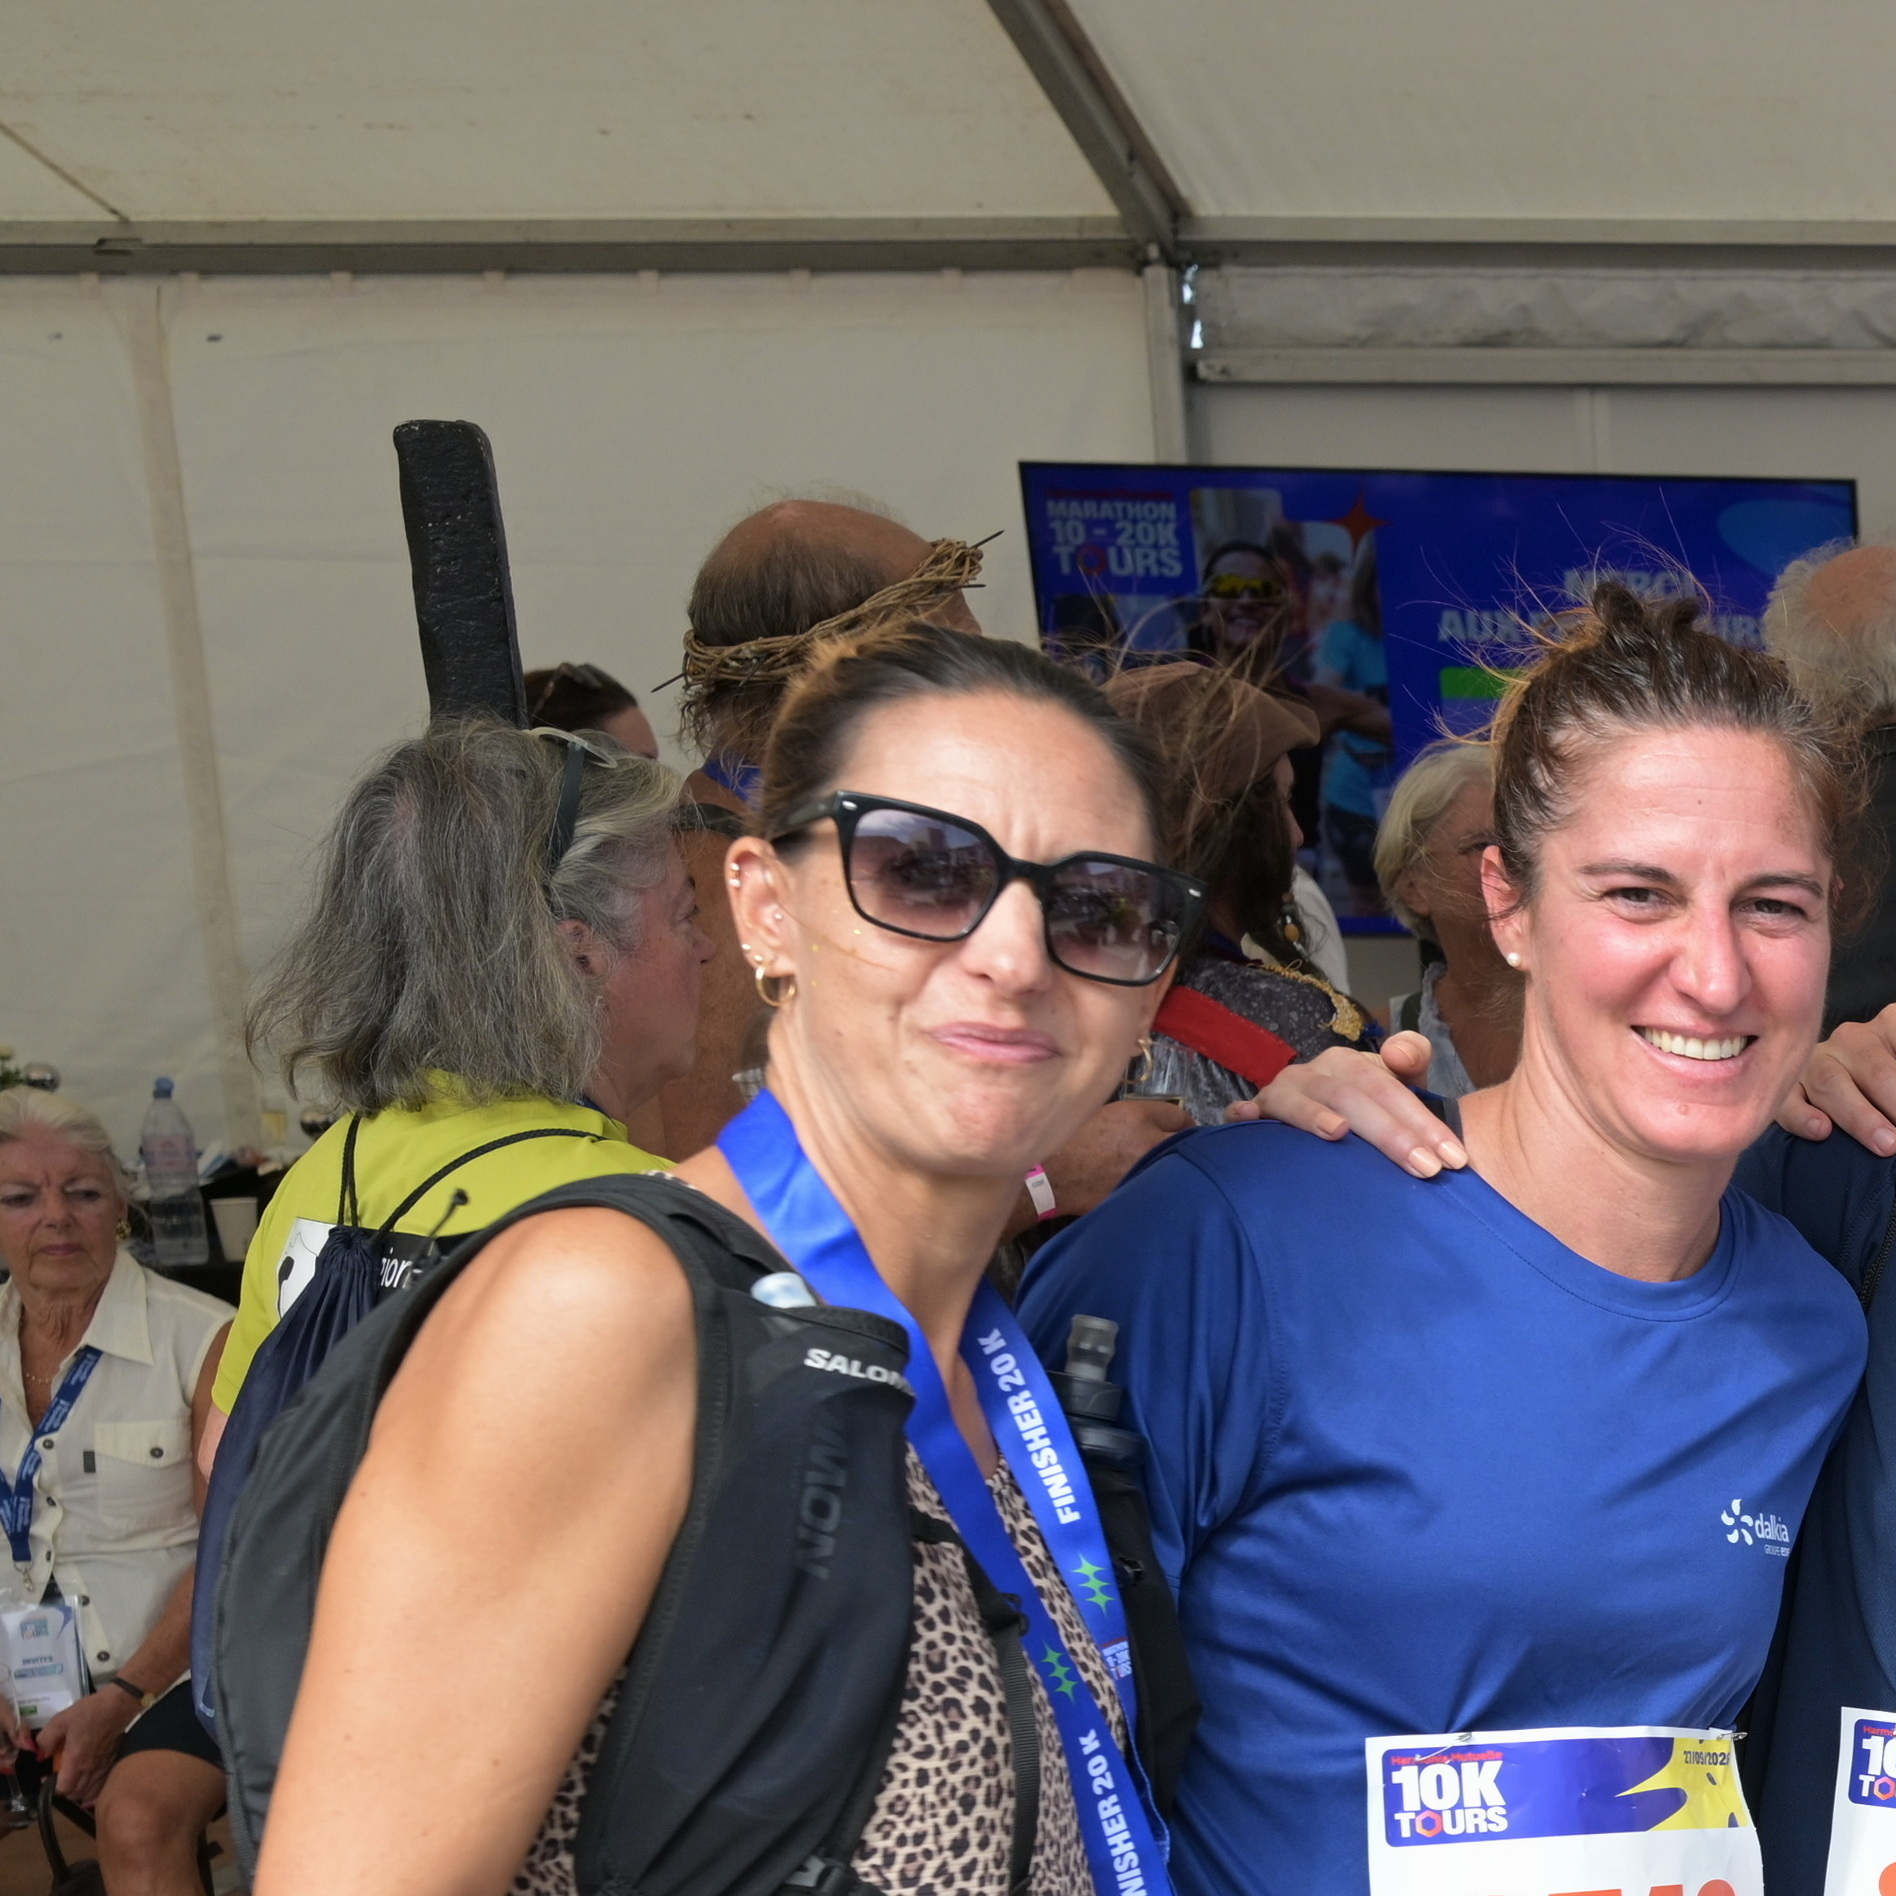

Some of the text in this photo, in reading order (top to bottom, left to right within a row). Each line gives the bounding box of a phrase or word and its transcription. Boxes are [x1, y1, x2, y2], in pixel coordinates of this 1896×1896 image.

[1047, 499, 1177, 519] MARATHON
[1050, 520, 1086, 546] 10
[1115, 521, 1180, 546] 20K
[1052, 545, 1184, 577] TOURS
[977, 1328, 1082, 1525] FINISHER 20 K
[1754, 1512, 1790, 1543] dalkia
[1078, 1728, 1101, 1756] K
[1087, 1754, 1115, 1796] 20
[1391, 1760, 1507, 1812] 10K
[1394, 1806, 1509, 1838] TOURS
